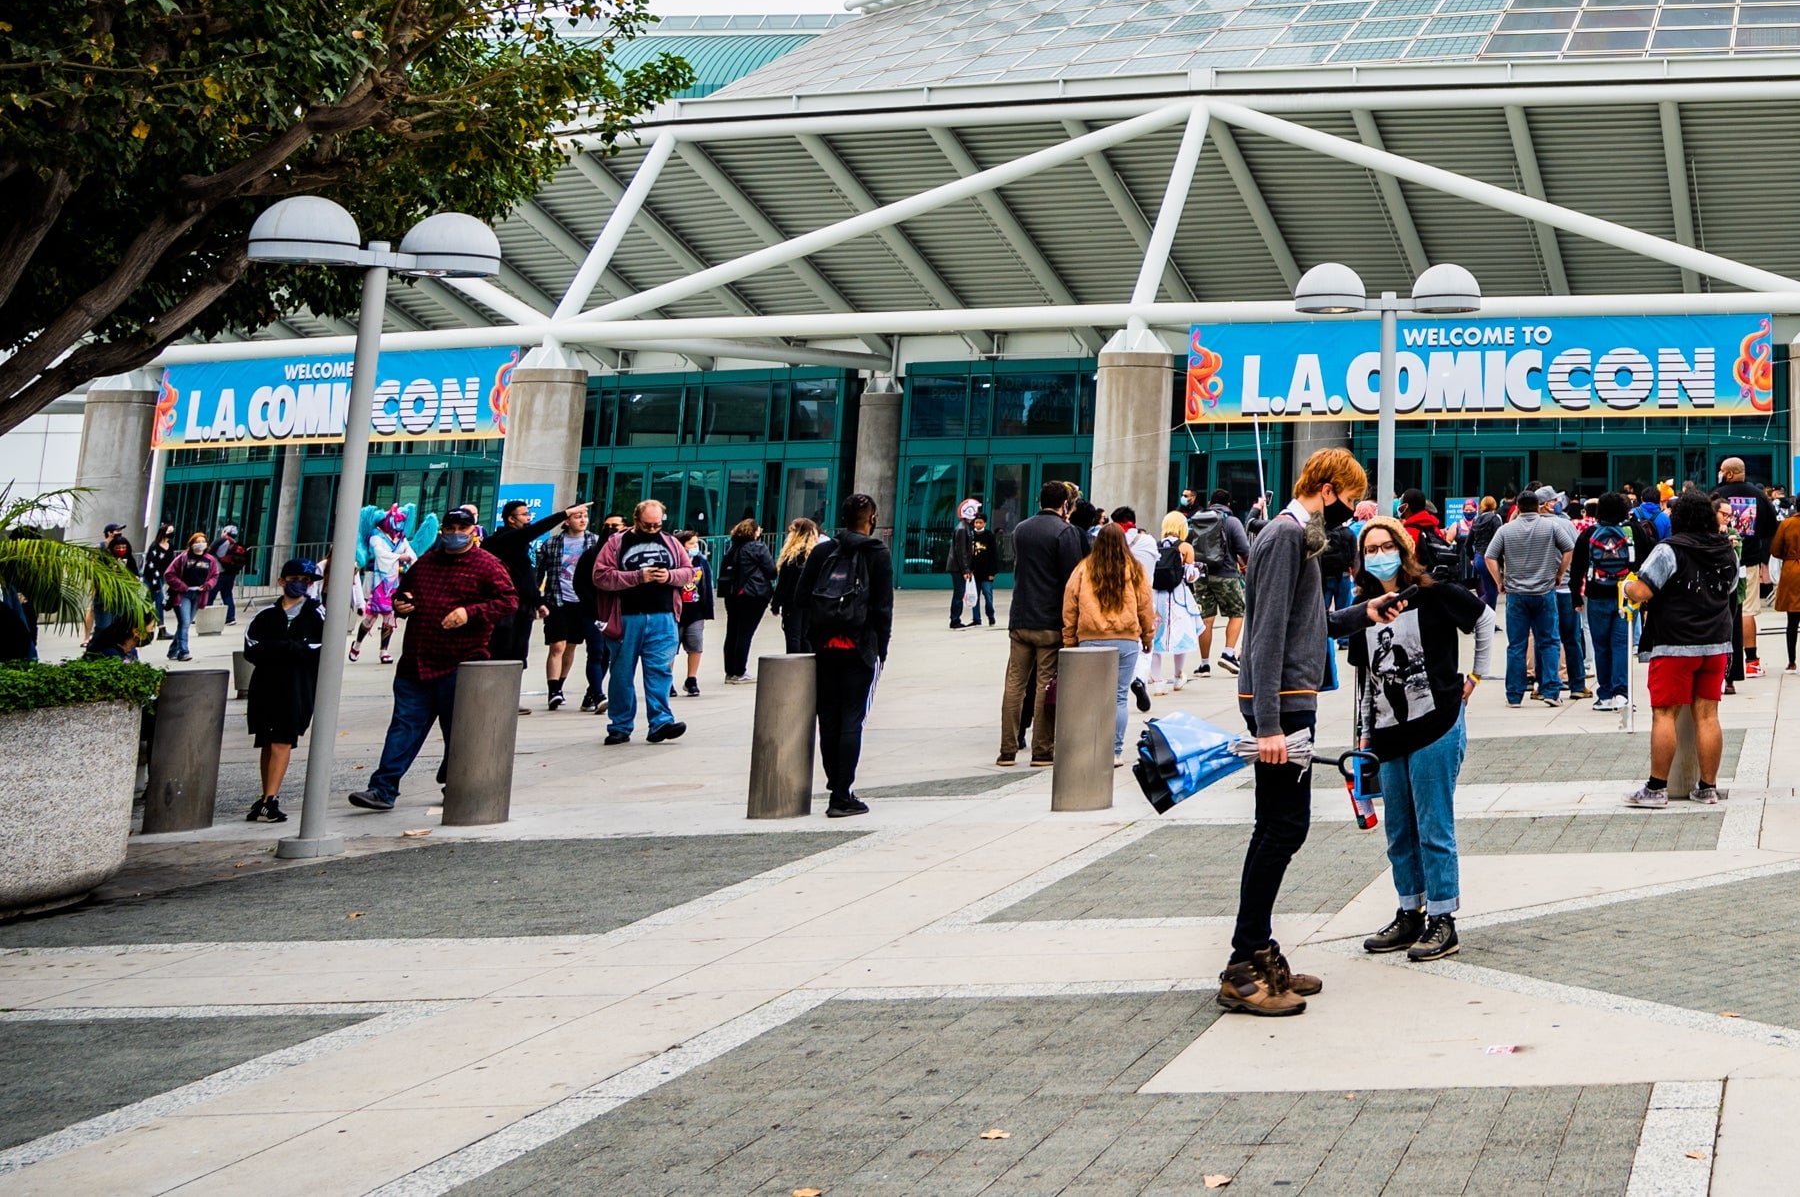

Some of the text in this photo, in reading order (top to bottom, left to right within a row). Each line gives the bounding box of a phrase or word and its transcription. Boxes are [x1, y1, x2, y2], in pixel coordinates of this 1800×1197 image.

[1403, 325, 1552, 347] WELCOME TO
[247, 382, 352, 440] COMI
[371, 376, 480, 435] CON
[1547, 346, 1715, 411] CON
